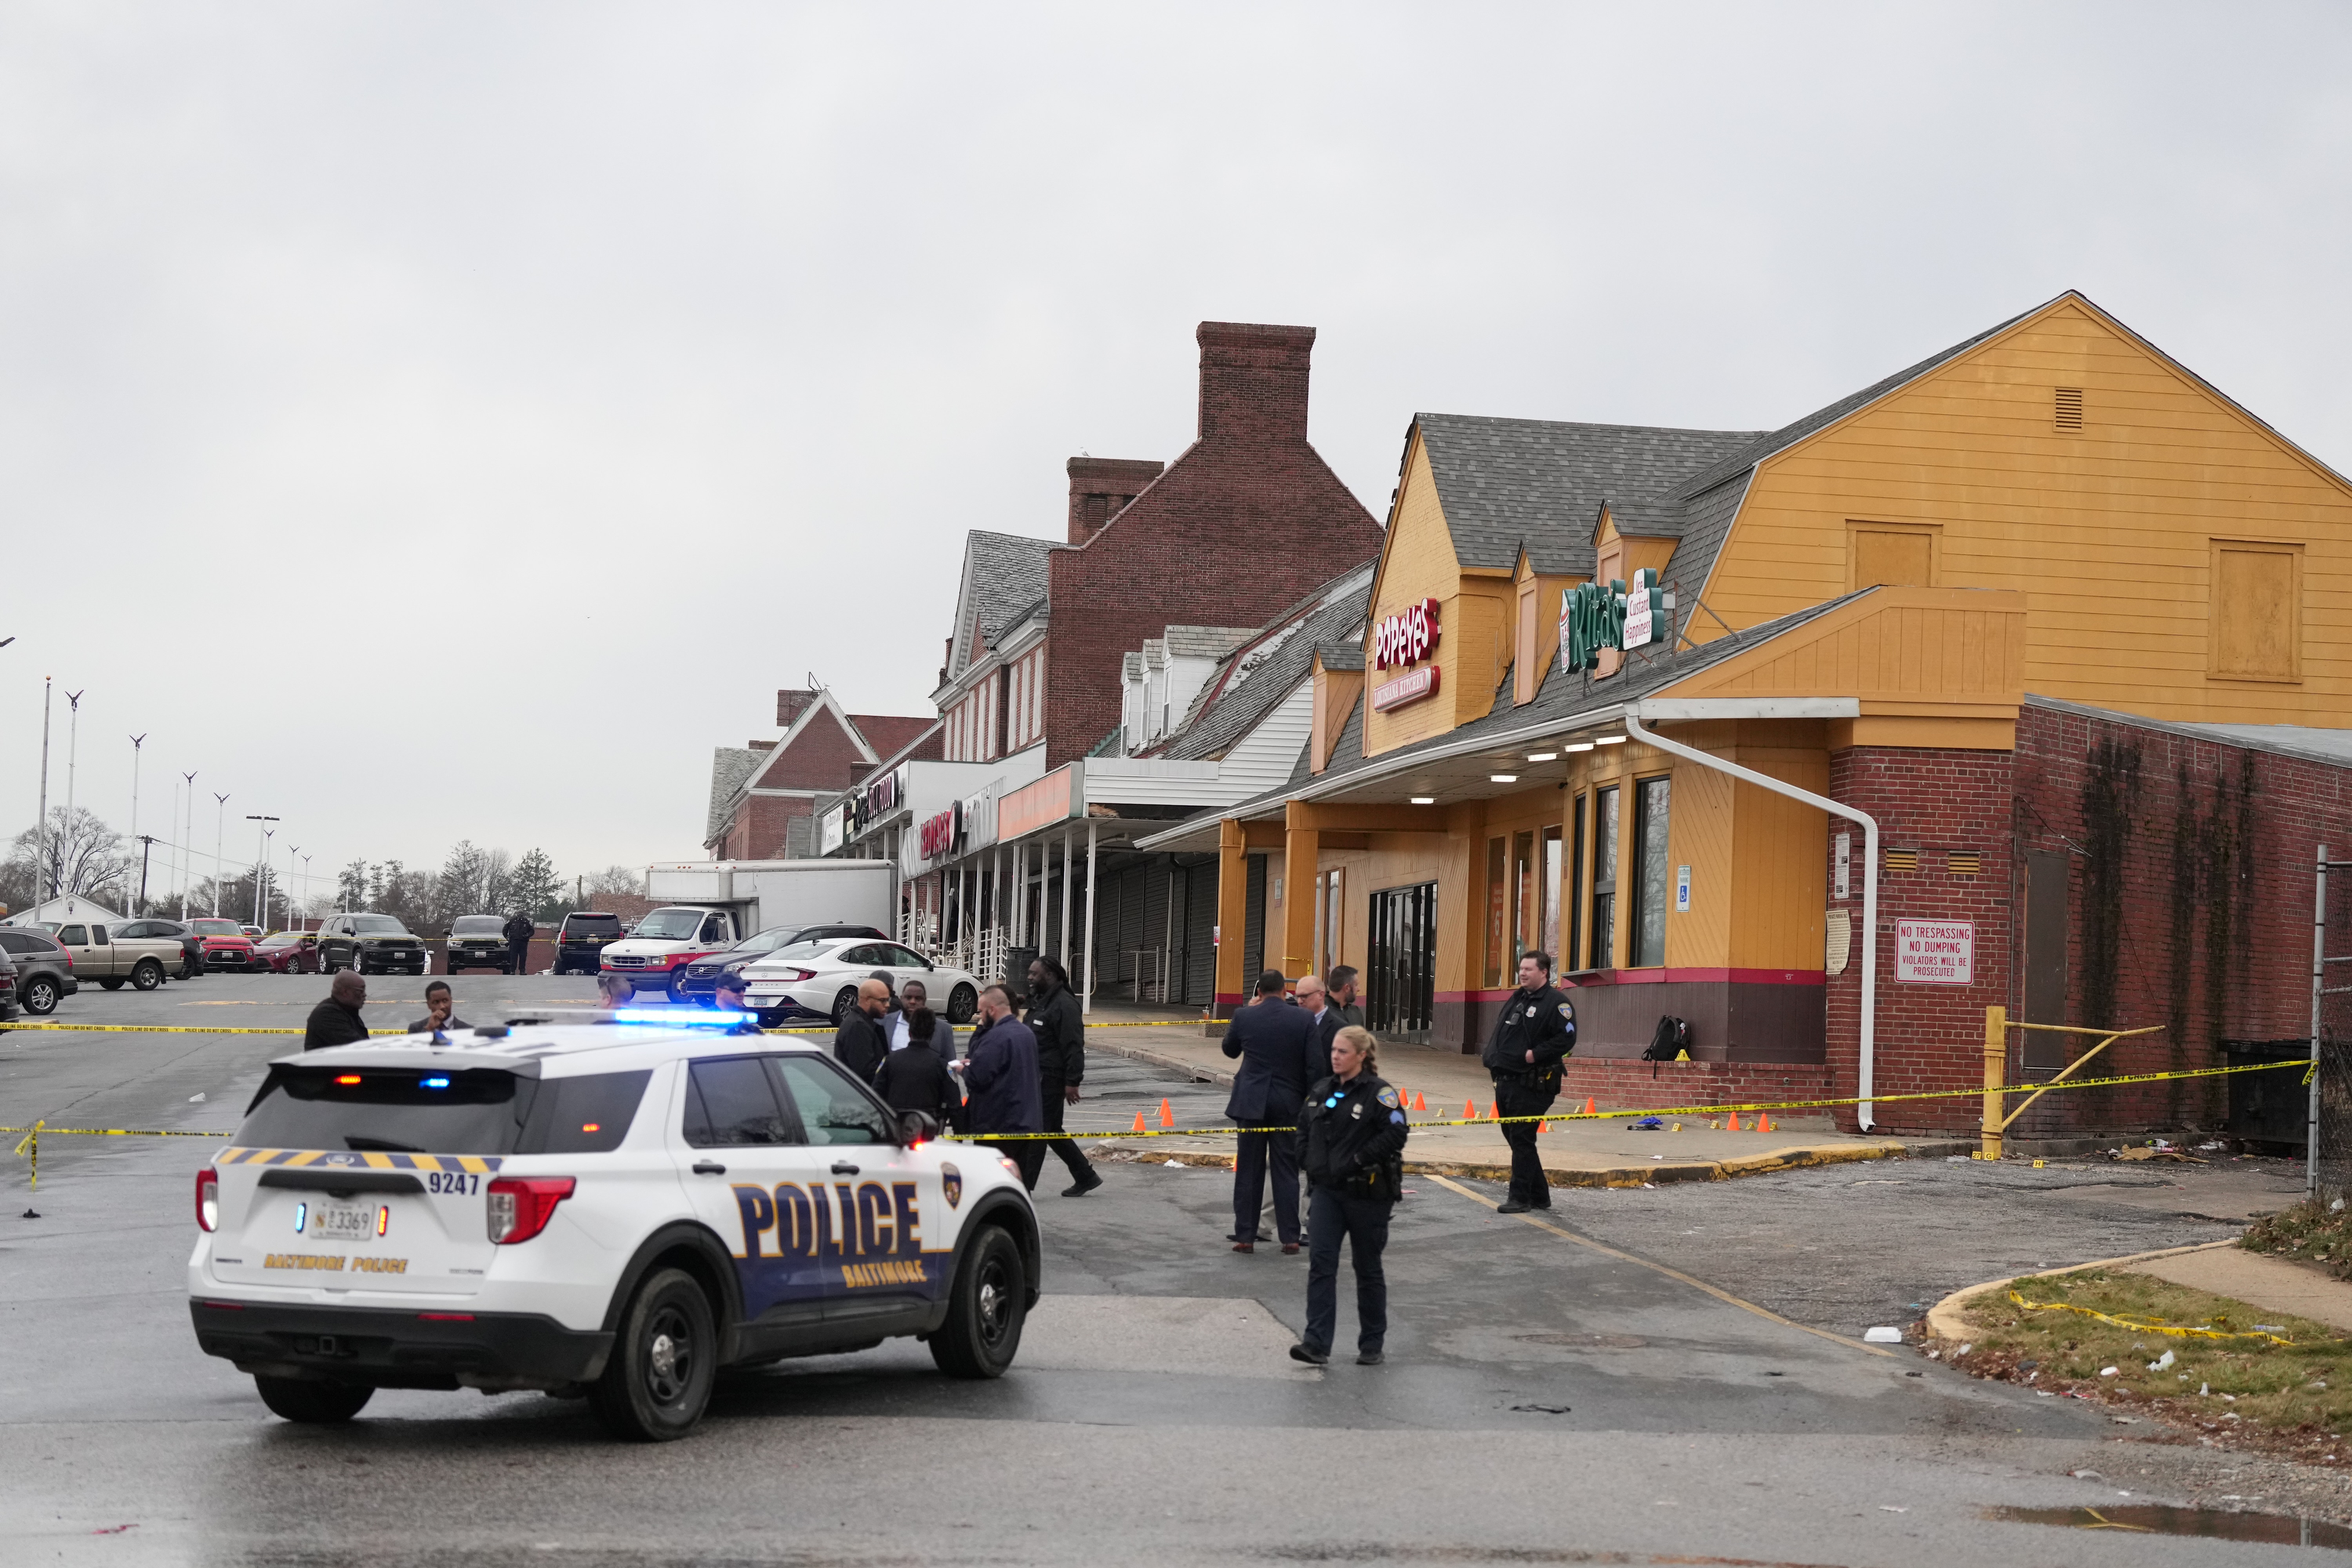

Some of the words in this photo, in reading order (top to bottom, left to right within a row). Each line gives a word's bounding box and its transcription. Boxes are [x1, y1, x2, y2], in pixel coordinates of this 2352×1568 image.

[1629, 597, 1649, 616] Custard
[1573, 579, 1622, 670] Rita's
[1625, 619, 1651, 644] Happiness
[1374, 681, 1399, 707] LOUISIANA
[1399, 672, 1425, 696] KITCHEN
[1900, 926, 1912, 938] NO
[1916, 927, 1970, 939] TRESPASSING
[1909, 941, 1921, 952] NO
[1925, 942, 1961, 953] DUMPING
[1902, 955, 1938, 965] VIOLATORS
[1940, 956, 1956, 966] WILL
[1958, 957, 1967, 967] BE
[1913, 966, 1955, 977] PROSECUTED
[429, 1172, 479, 1196] 9247
[336, 1211, 370, 1230] 3369
[731, 1181, 922, 1258] POLICE
[263, 1253, 346, 1271] BALTIMORE
[351, 1256, 409, 1274] POLICE
[840, 1260, 927, 1288] BALTIMORE
